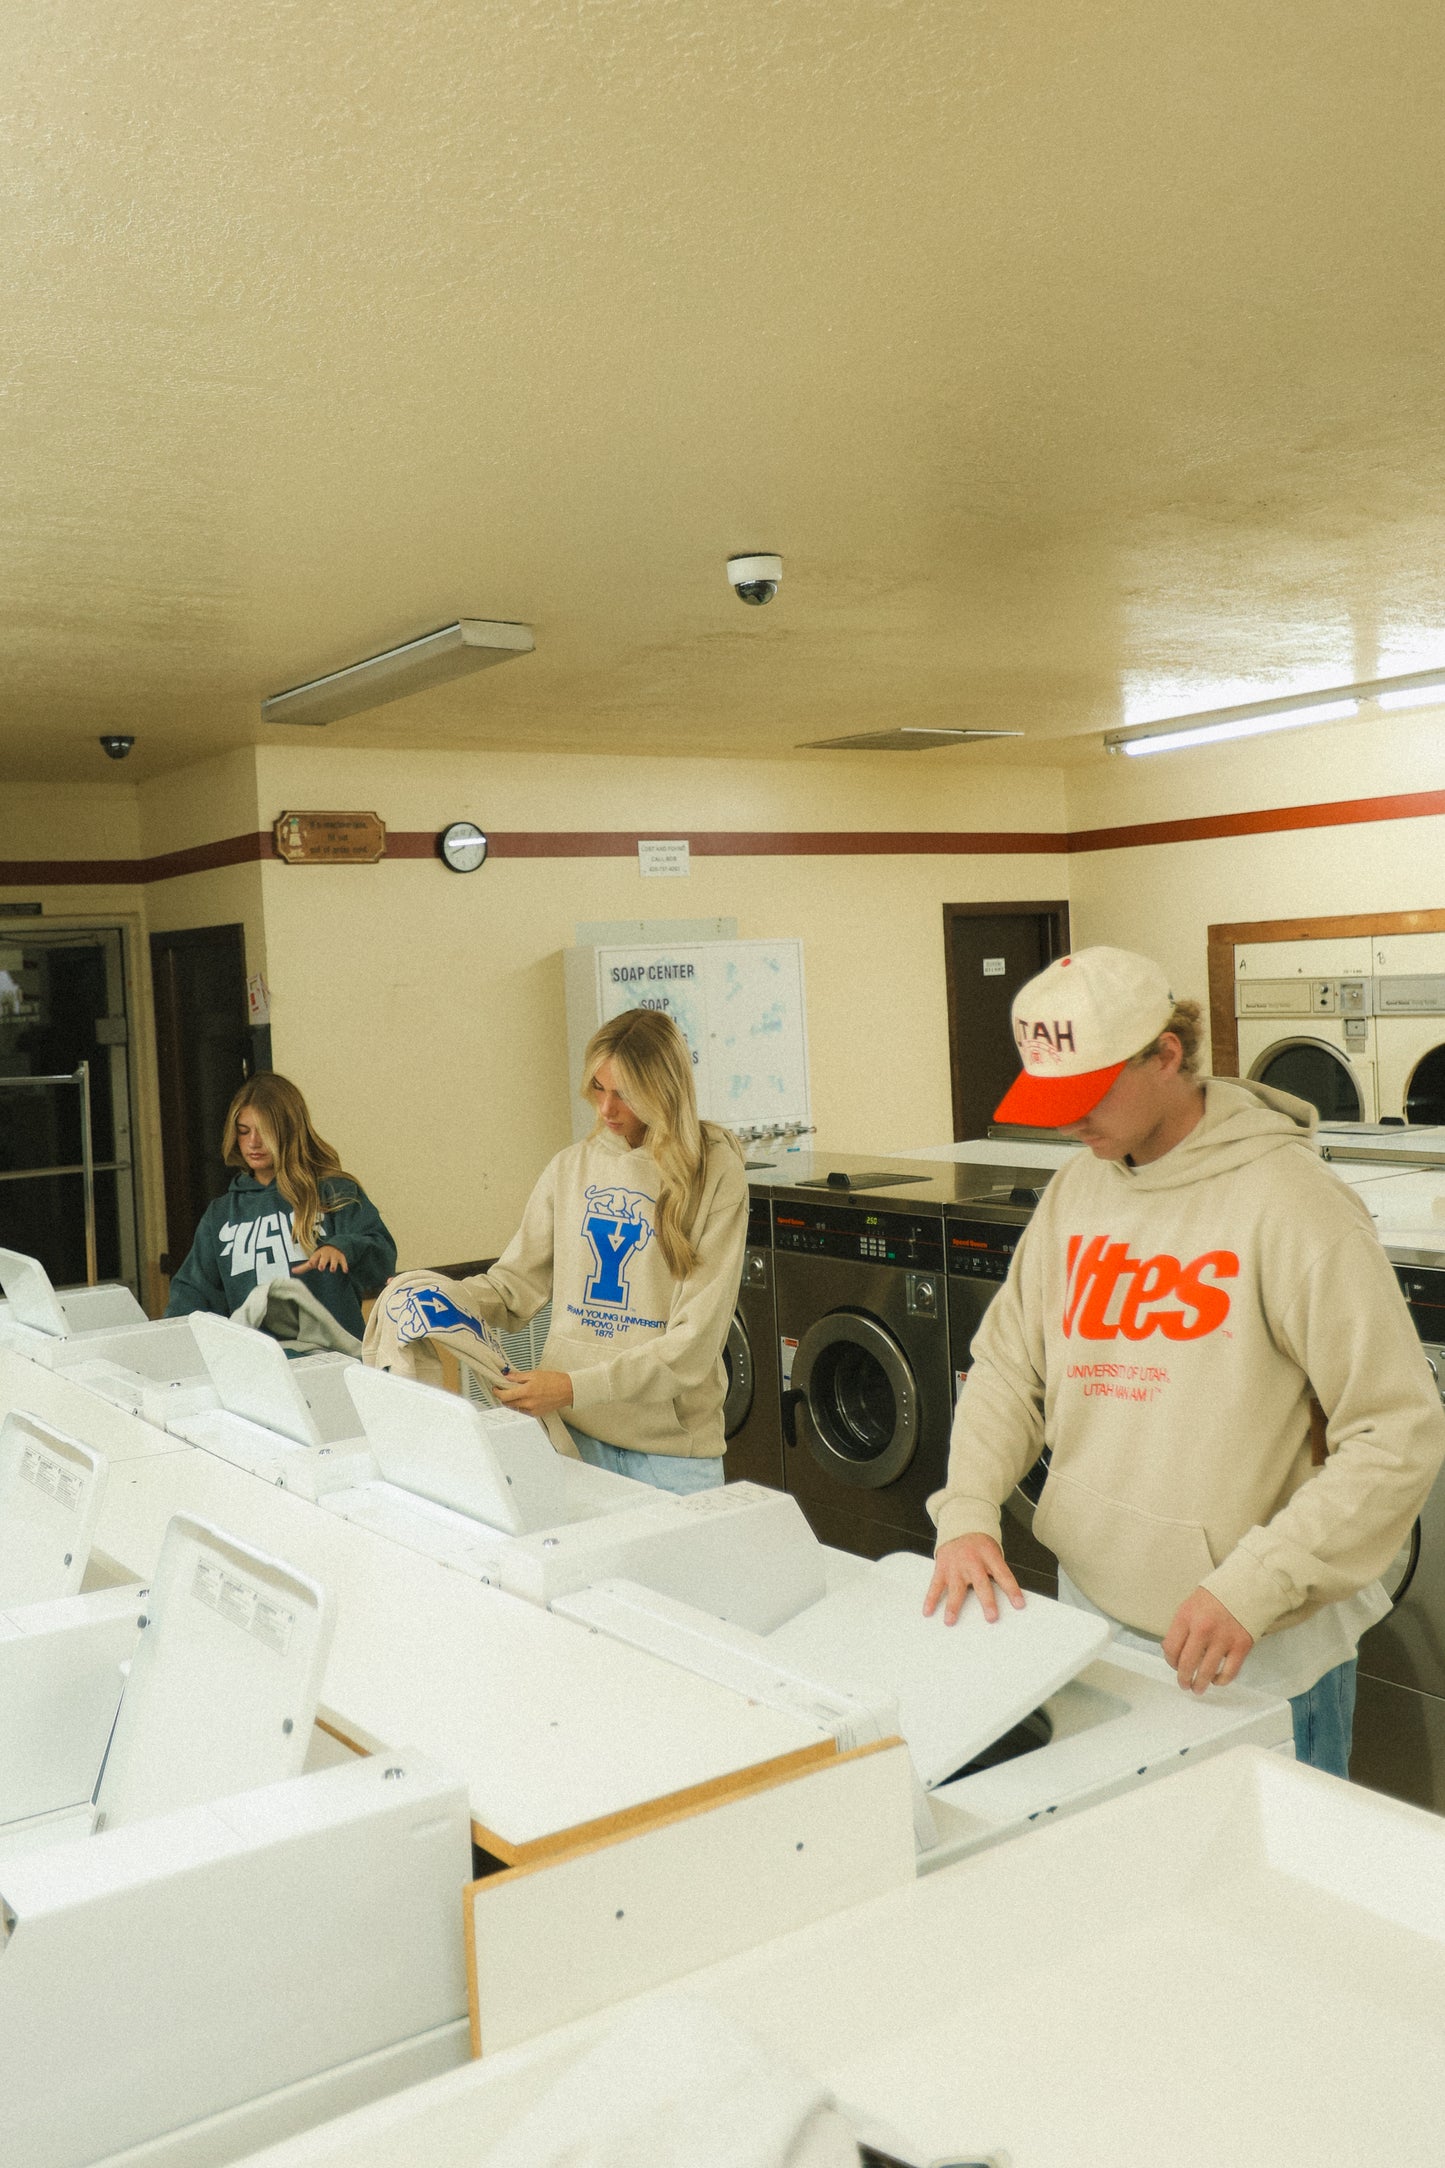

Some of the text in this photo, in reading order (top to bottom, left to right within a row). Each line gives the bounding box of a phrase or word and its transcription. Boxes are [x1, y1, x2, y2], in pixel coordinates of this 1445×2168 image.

[613, 964, 695, 982] SOAP CENTER
[641, 998, 670, 1010] SOAP
[1014, 1017, 1076, 1053] TAH
[581, 1211, 643, 1311] Y
[581, 1318, 630, 1333] PROVO, UT
[585, 1309, 619, 1322] YOUNG
[620, 1315, 669, 1329] UNIVERSITY
[594, 1328, 614, 1339] 1875
[1066, 1363, 1126, 1379] UNIVERSIT
[1083, 1383, 1114, 1397] UTAH
